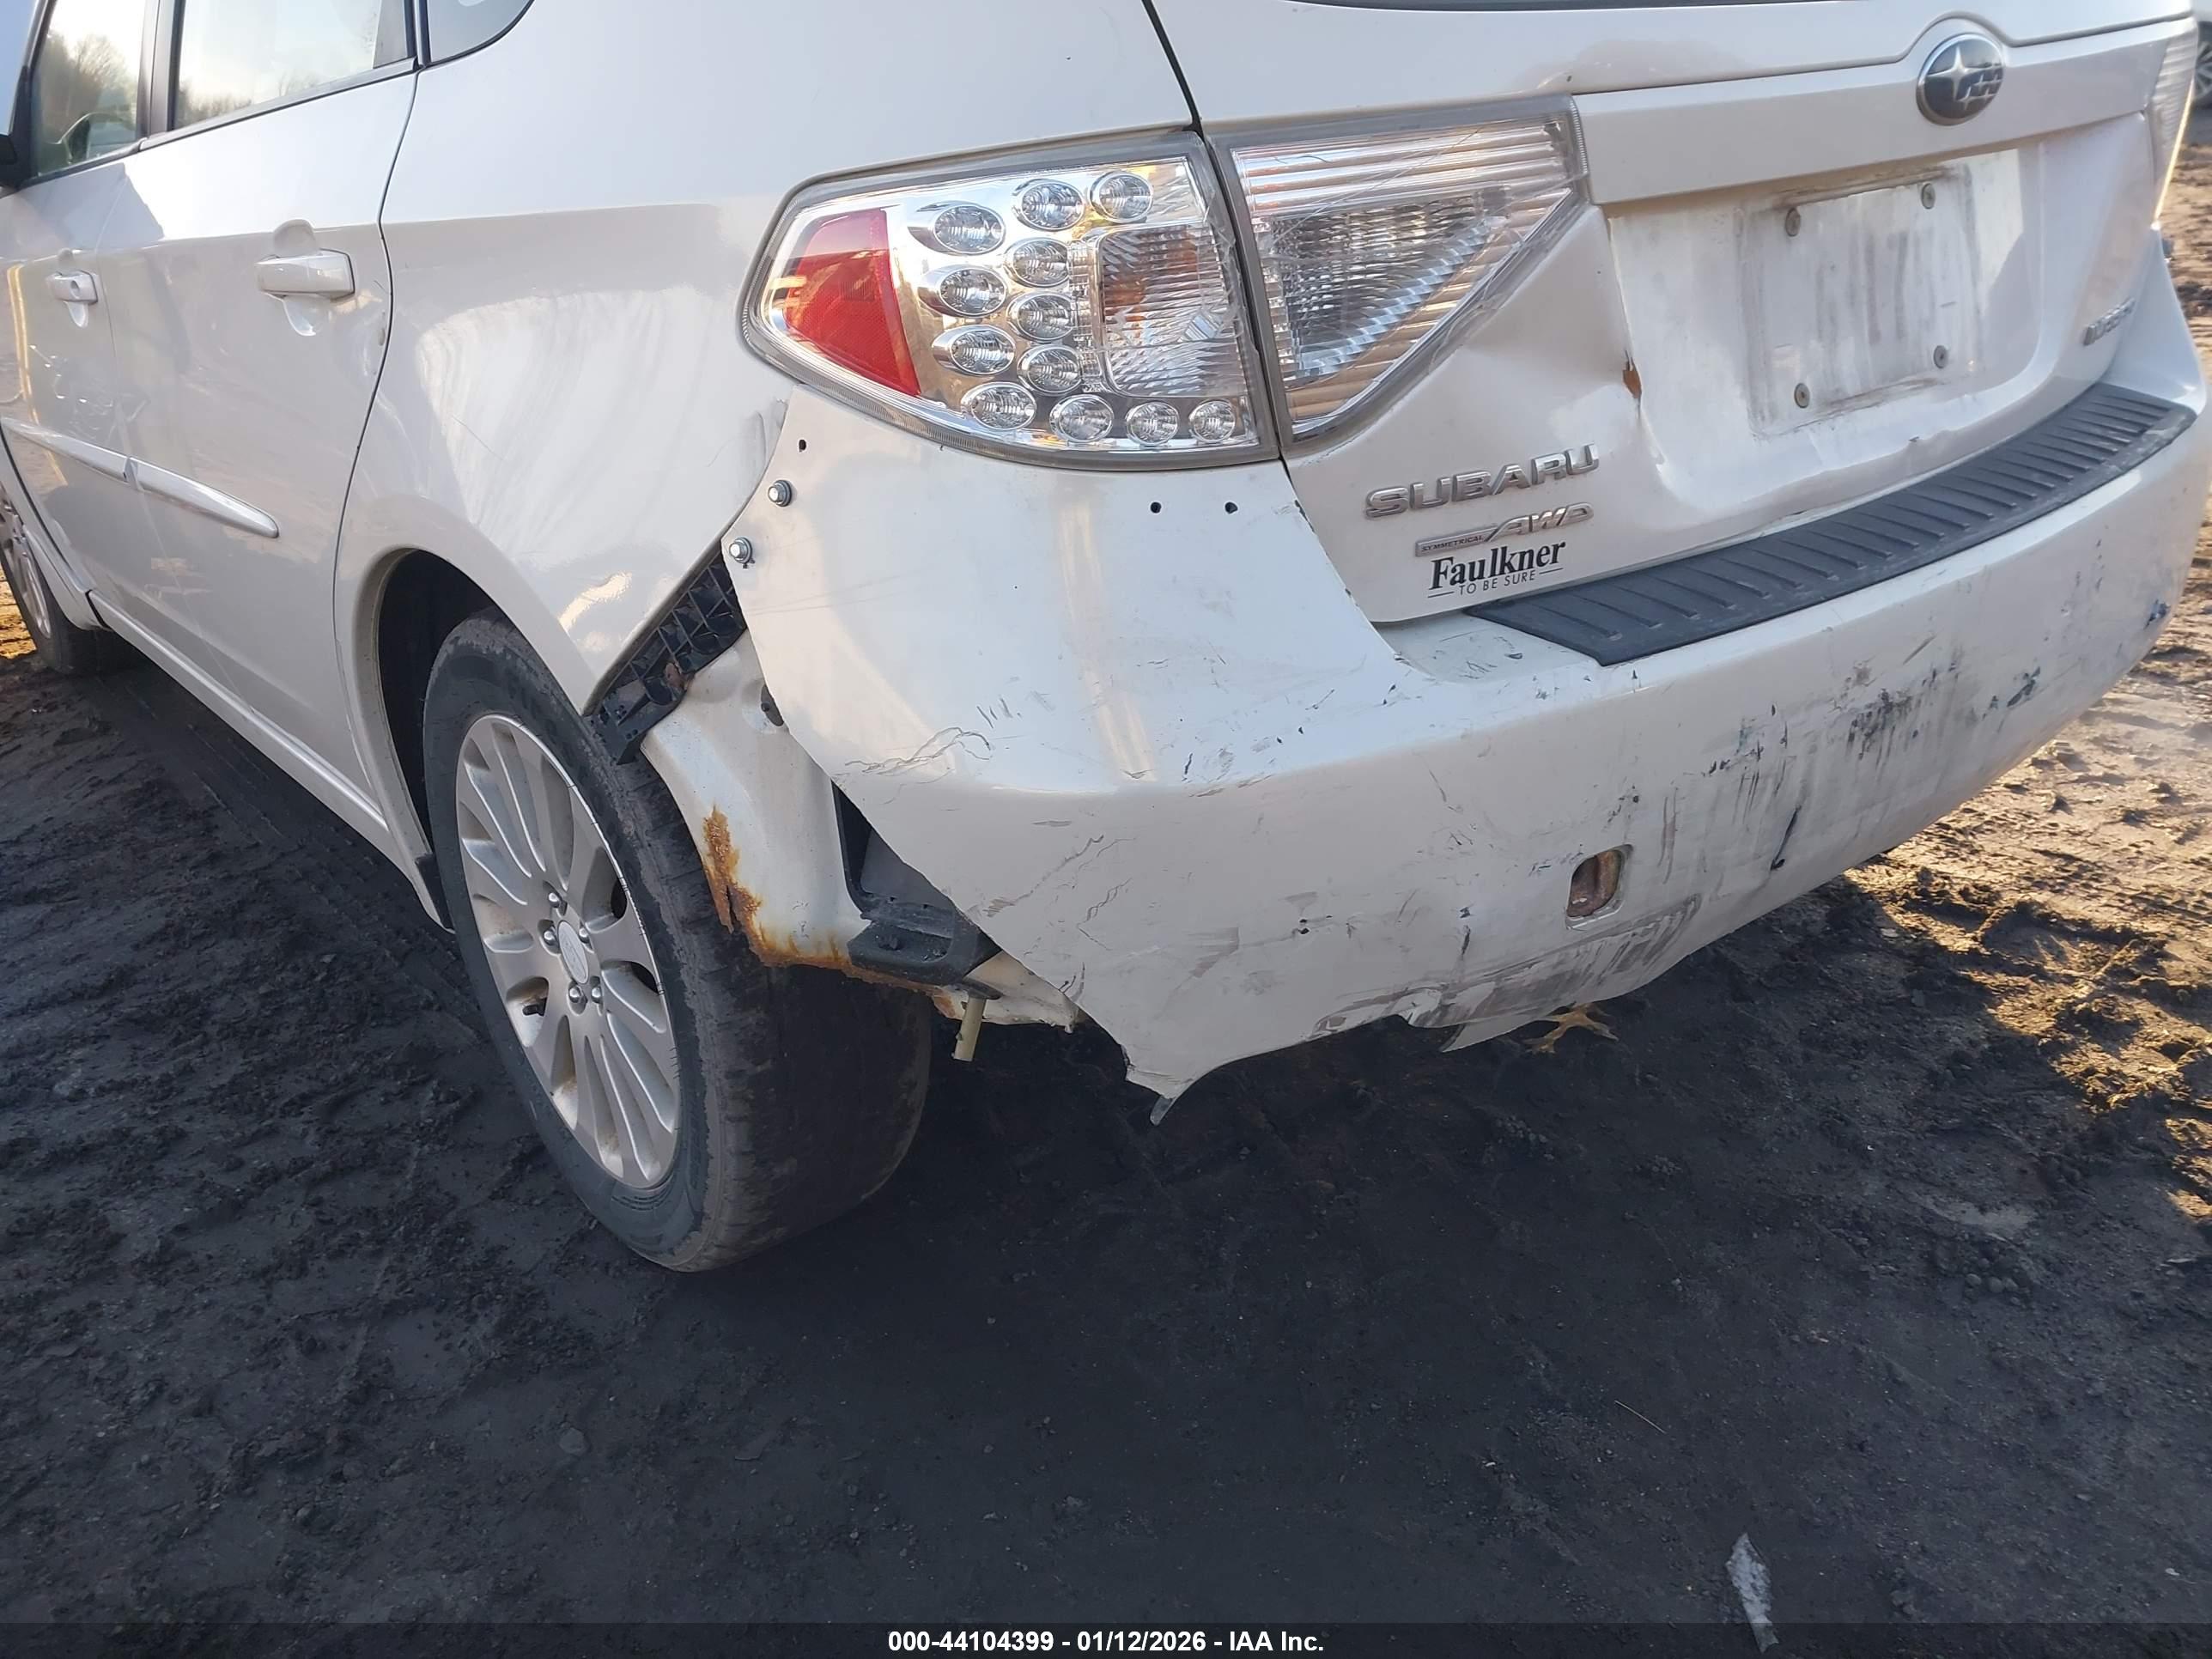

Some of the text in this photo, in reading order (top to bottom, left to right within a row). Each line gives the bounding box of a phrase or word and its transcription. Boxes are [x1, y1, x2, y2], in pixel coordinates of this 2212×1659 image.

[1366, 443, 1599, 518] SUBARU
[1421, 502, 1594, 552] SYMMETRICAL AWD
[1428, 541, 1566, 590] Faulkner
[1460, 569, 1536, 595] TO BE SURE
